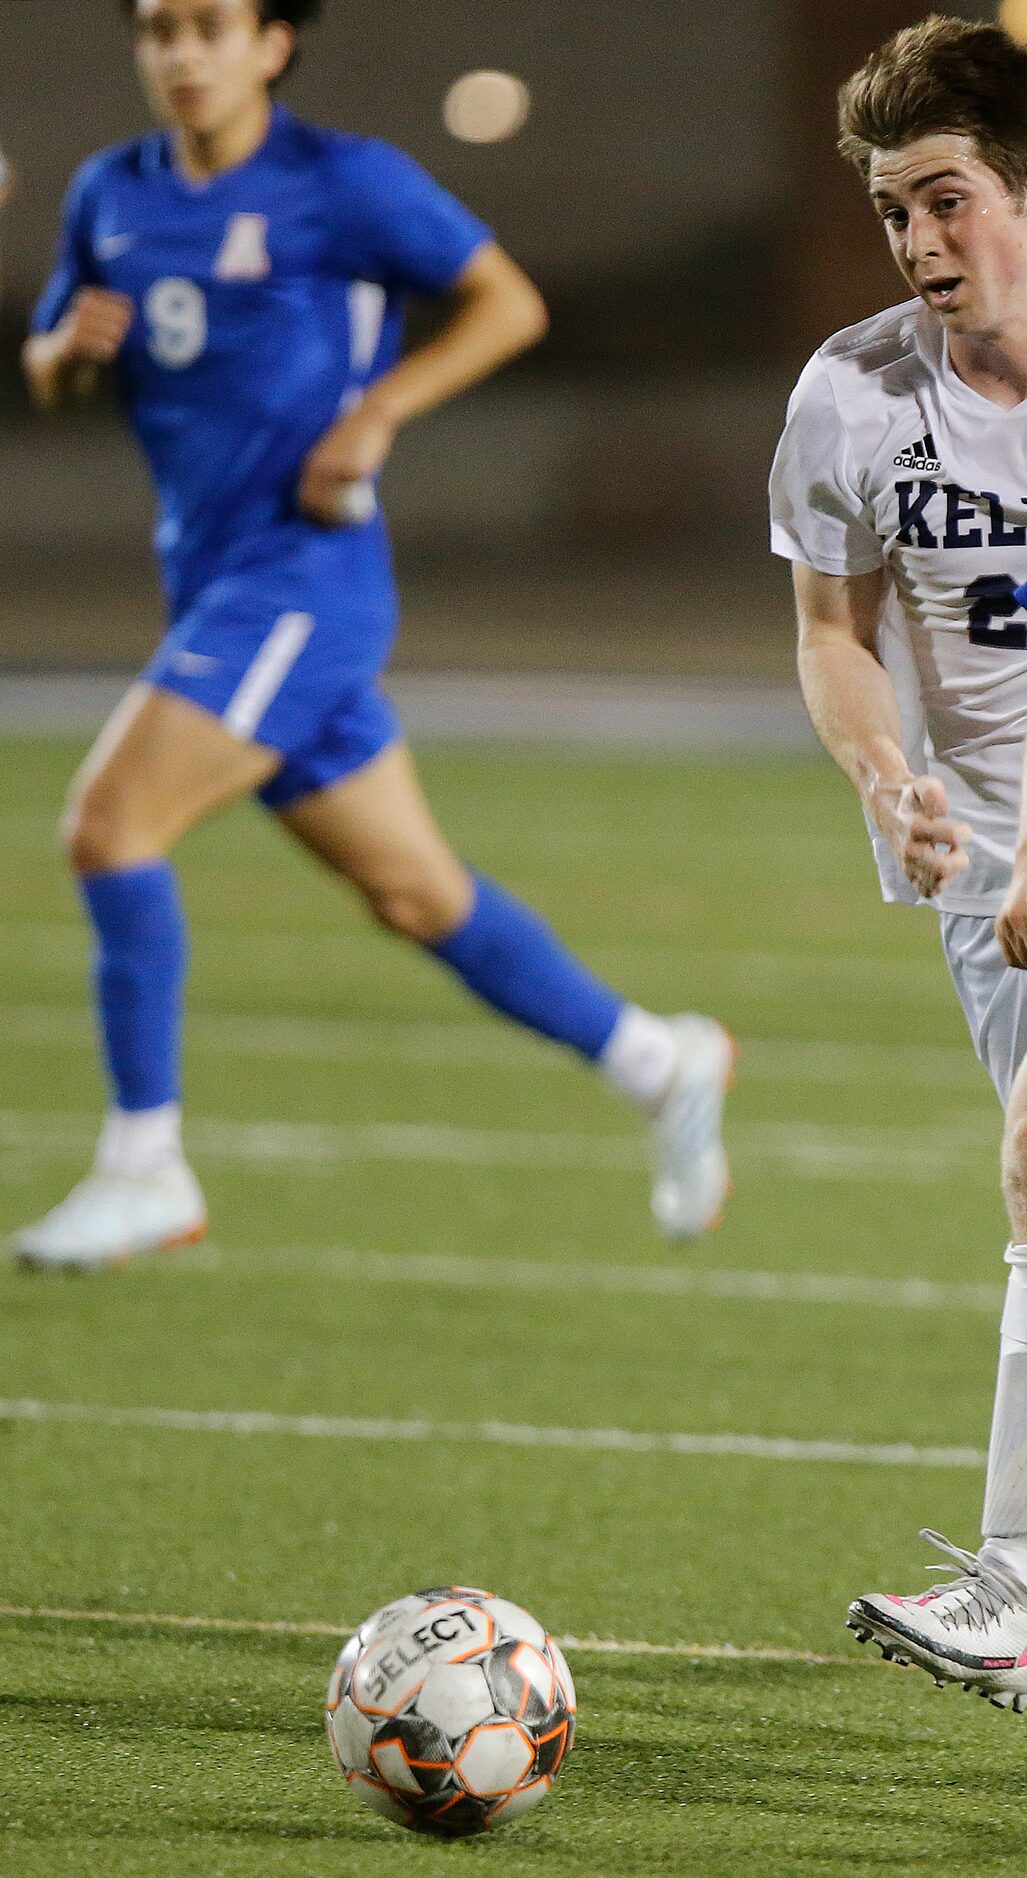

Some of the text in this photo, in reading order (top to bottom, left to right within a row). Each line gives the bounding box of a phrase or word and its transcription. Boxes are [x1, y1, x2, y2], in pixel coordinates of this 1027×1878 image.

[144, 277, 207, 369] 9
[893, 455, 942, 471] adidas
[364, 1609, 476, 1703] SELECT
